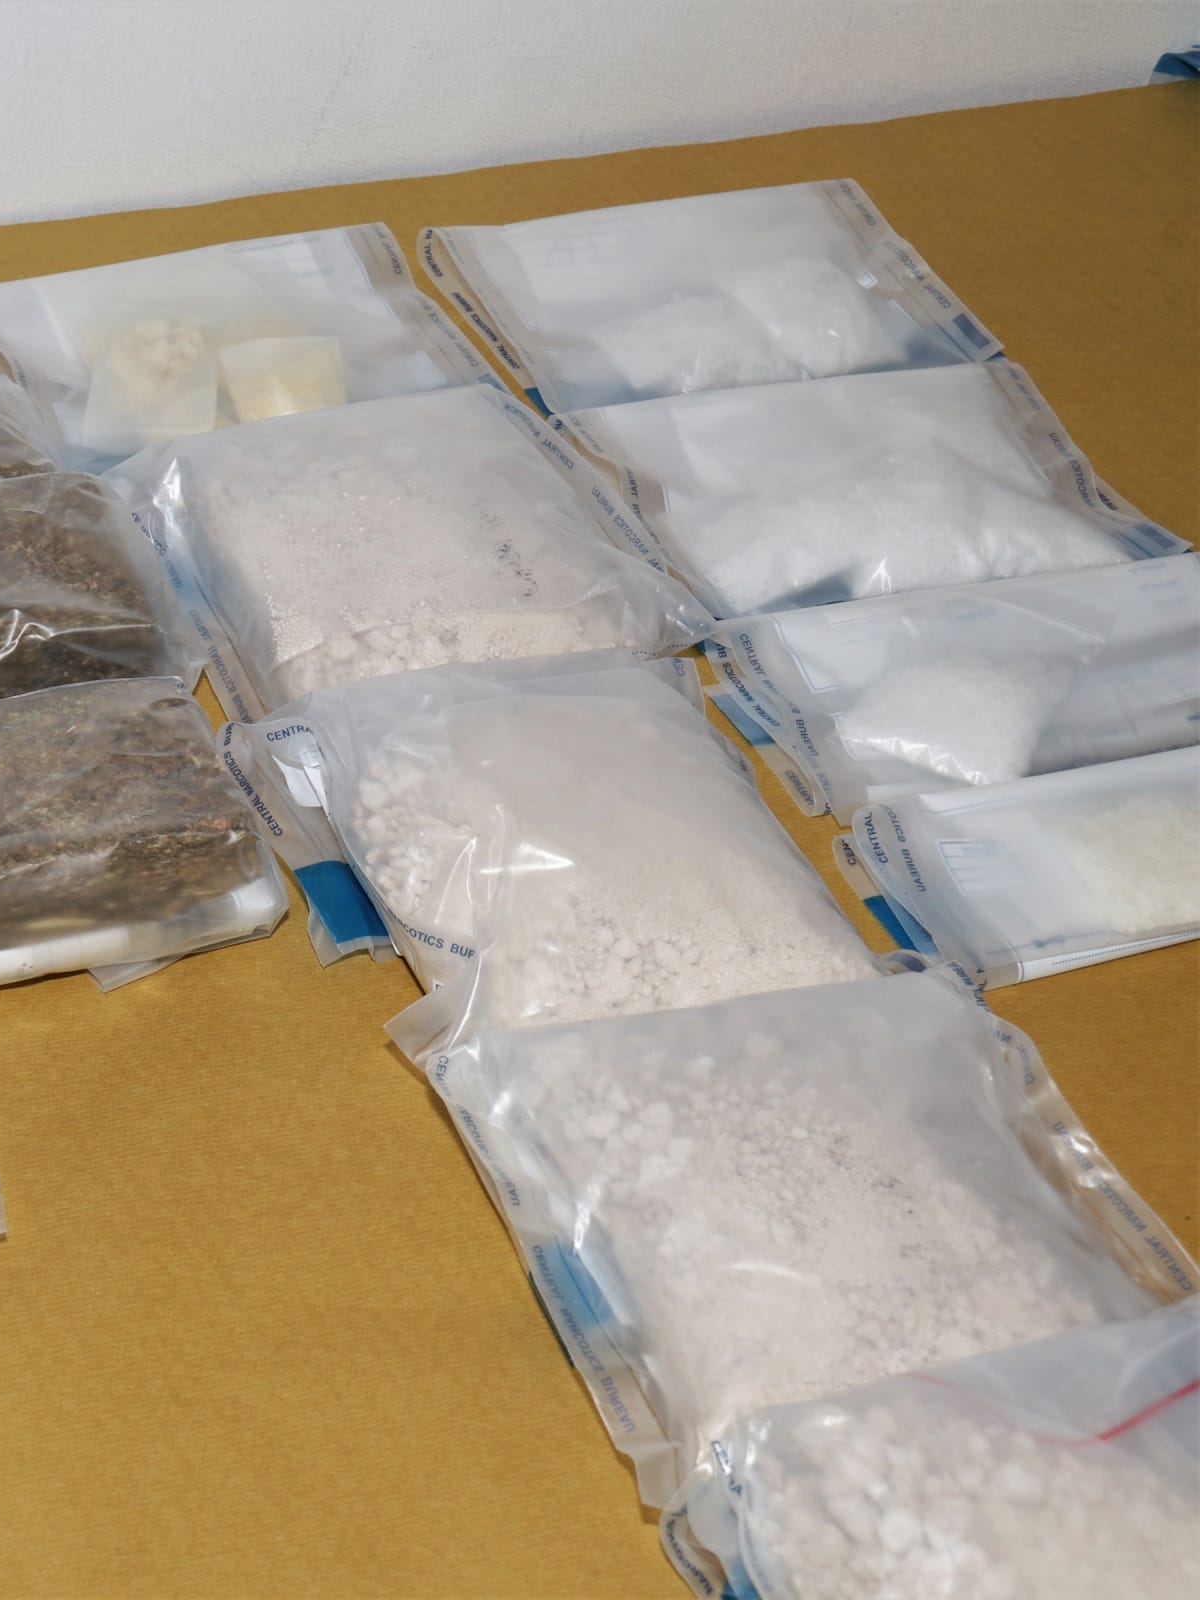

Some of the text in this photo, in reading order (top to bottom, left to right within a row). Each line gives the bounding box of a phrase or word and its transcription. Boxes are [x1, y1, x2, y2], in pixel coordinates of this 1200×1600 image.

[424, 243, 443, 277] CENTRAL
[497, 343, 520, 370] CENTRAL
[722, 662, 754, 702] NARCOTICS
[267, 725, 314, 742] CENTRA
[223, 751, 255, 796] NARCOTICS
[251, 794, 283, 837] CENTRAL
[864, 812, 889, 864] CENTRAL
